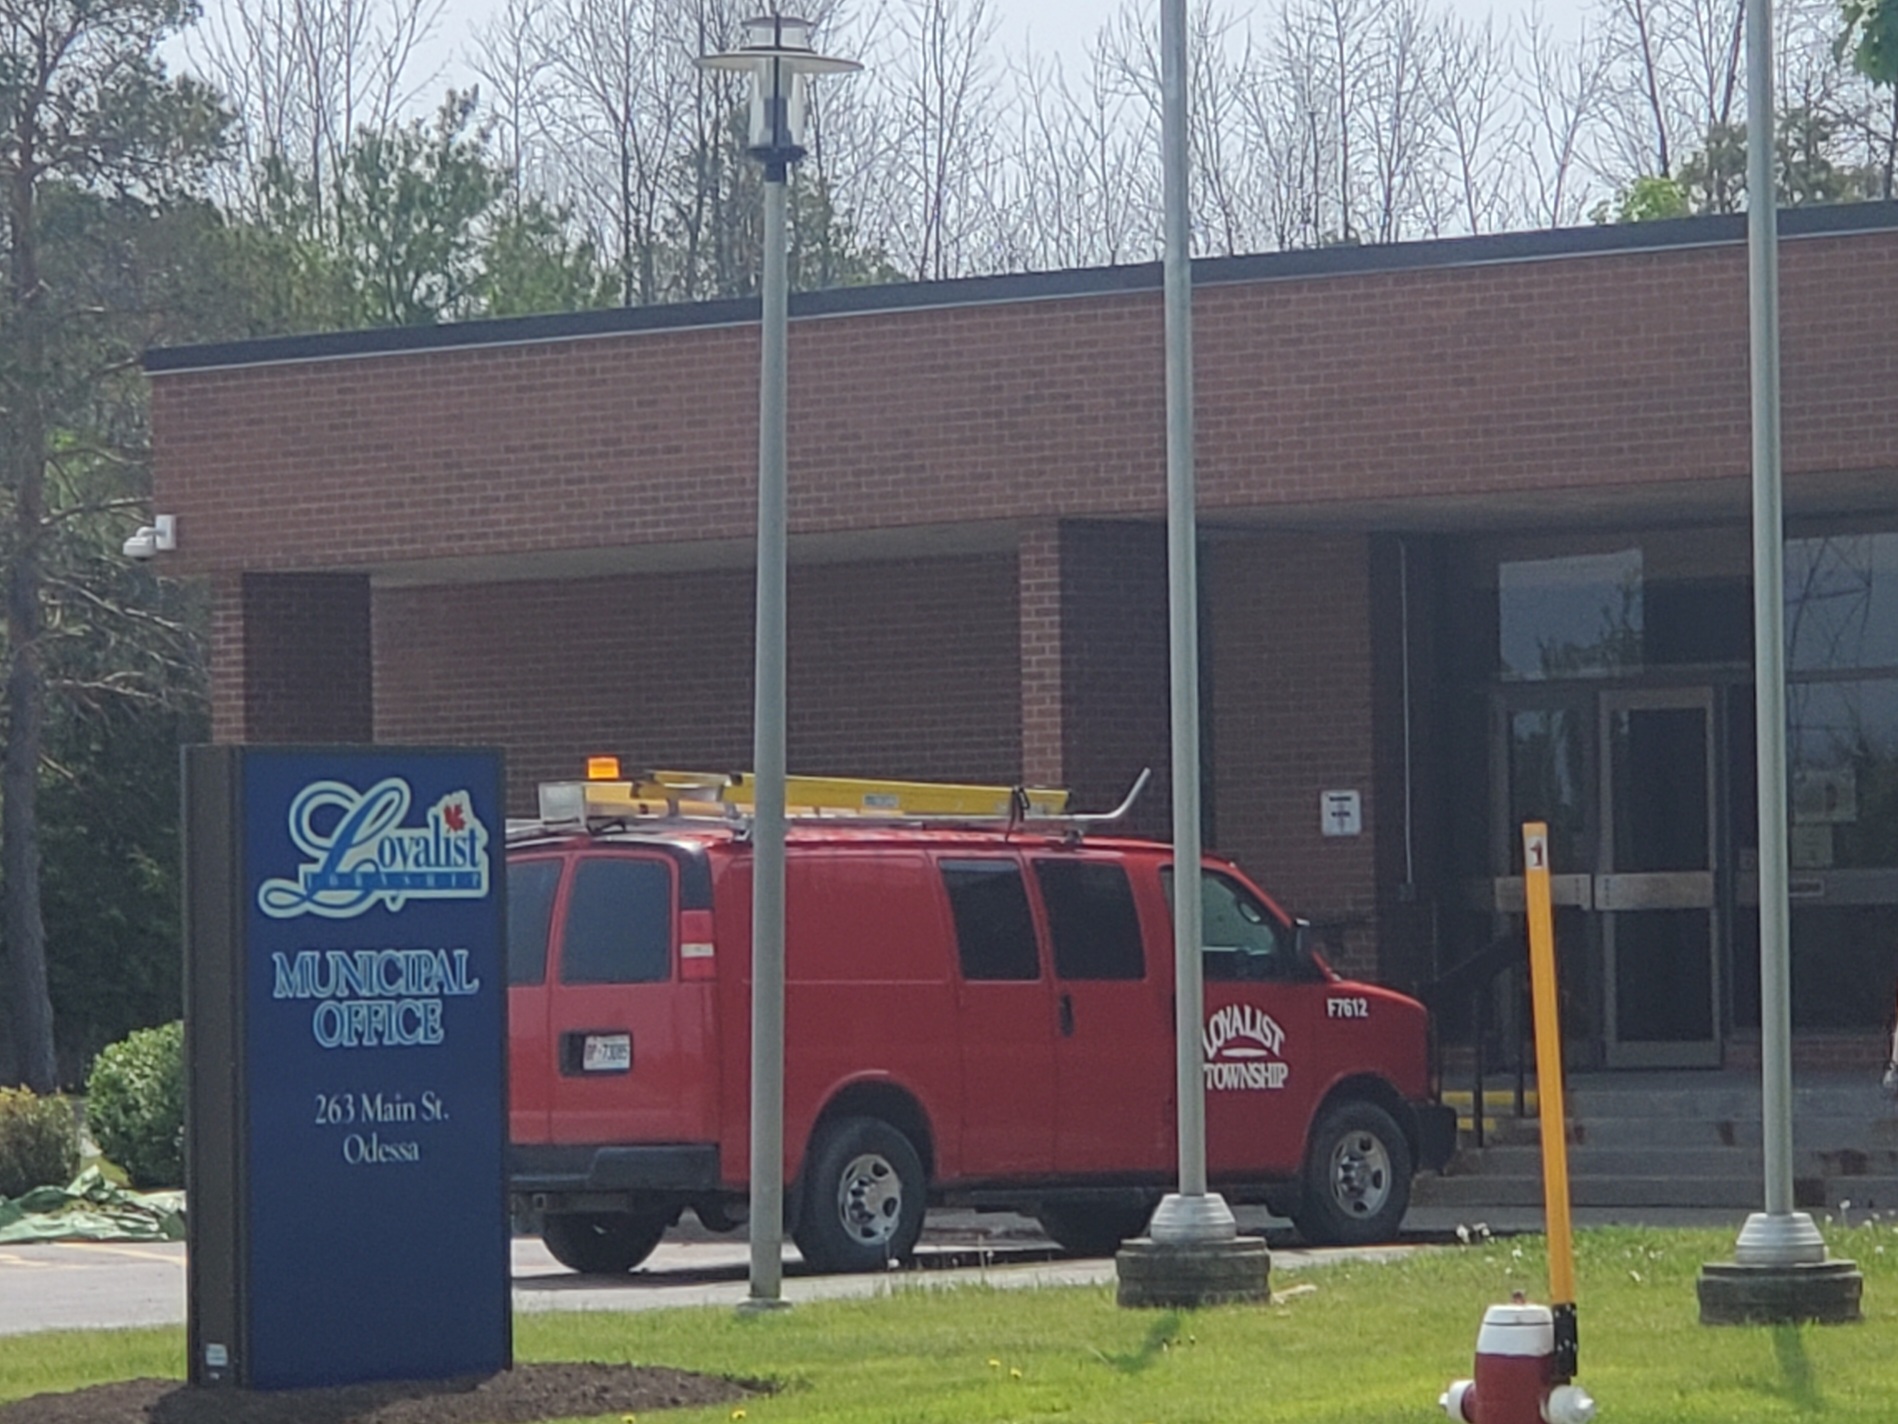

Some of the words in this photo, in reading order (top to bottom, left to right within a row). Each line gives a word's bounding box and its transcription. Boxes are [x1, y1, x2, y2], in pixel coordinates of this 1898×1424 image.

[261, 781, 483, 910] Loyalist
[272, 949, 479, 998] MUNICIPAL
[313, 999, 444, 1047] OFFICE
[1327, 998, 1368, 1018] F7612
[1202, 1003, 1285, 1059] LOYALIST
[1203, 1062, 1288, 1089] TOWNSHIP
[315, 1094, 355, 1124] 263
[361, 1093, 416, 1122] Main
[421, 1091, 449, 1121] St.
[343, 1132, 419, 1164] Odessa
